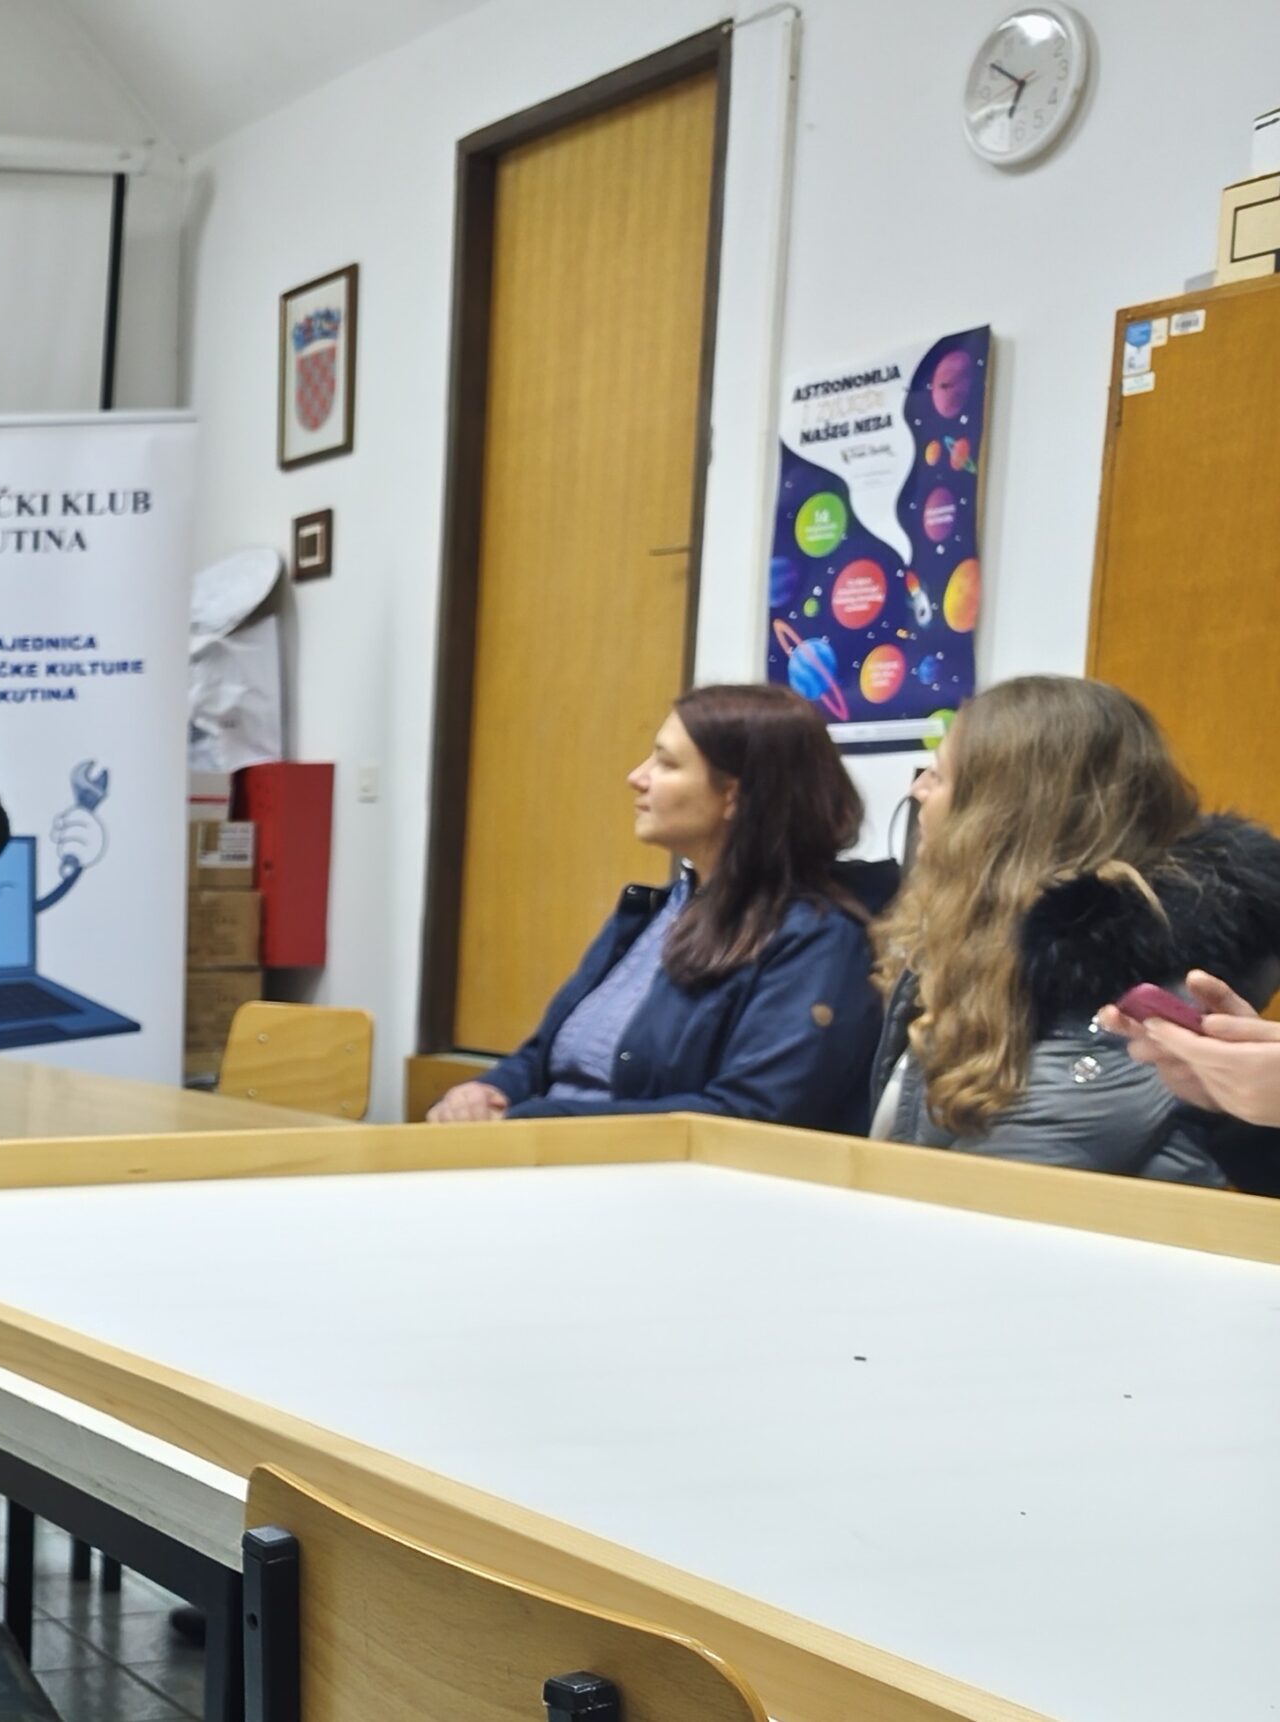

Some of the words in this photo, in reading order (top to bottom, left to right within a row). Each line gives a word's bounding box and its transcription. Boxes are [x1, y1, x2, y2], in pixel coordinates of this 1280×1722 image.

[792, 364, 901, 403] ASTRONOMIJA
[853, 414, 893, 435] NEBA
[60, 490, 154, 517] KLUB
[44, 659, 145, 678] KULTURE
